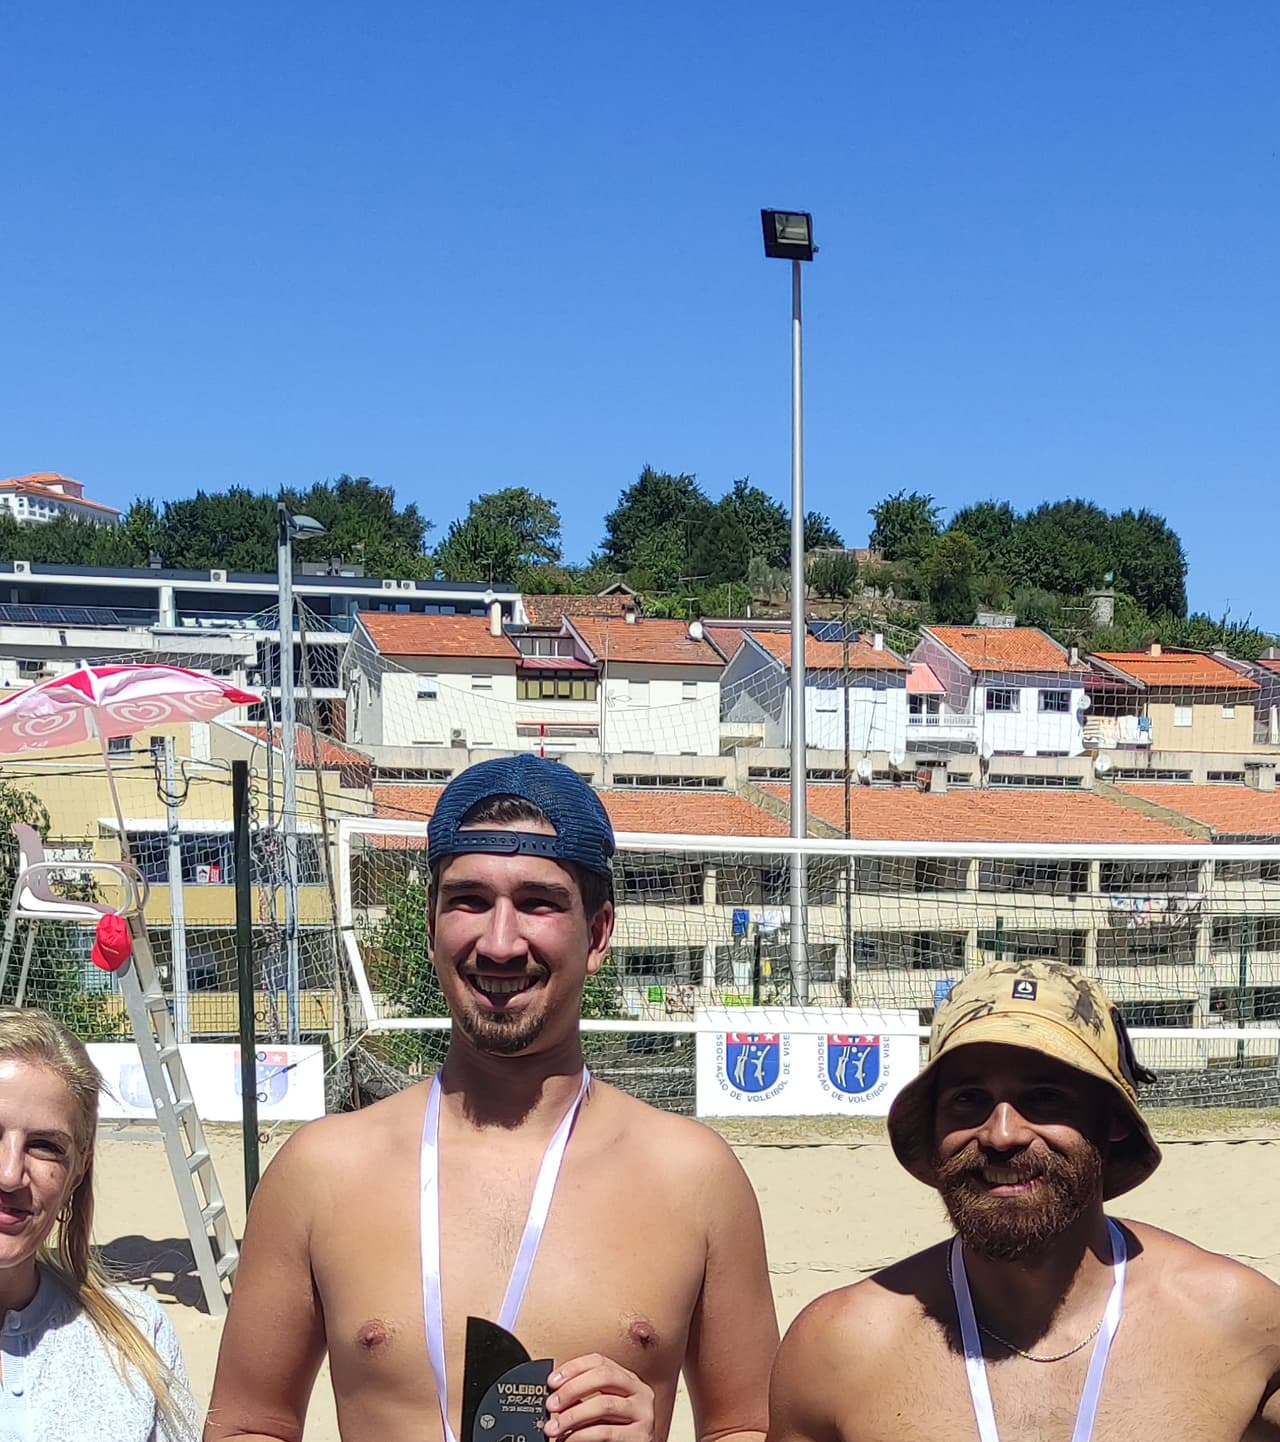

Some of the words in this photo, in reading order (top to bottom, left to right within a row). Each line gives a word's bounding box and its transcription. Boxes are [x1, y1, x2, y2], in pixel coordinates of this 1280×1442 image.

[783, 1033, 791, 1057] VISE
[715, 1034, 729, 1091] SSOCIAÇÃO
[783, 1061, 791, 1075] DE
[747, 1079, 789, 1103] VOLEIBOL
[831, 1091, 844, 1102] DE
[848, 1081, 888, 1104] VOLEIBOL
[882, 1064, 890, 1077] DE
[729, 1090, 742, 1101] DE
[497, 1383, 549, 1396] VOLEIBOL
[506, 1395, 544, 1406] PRAIA
